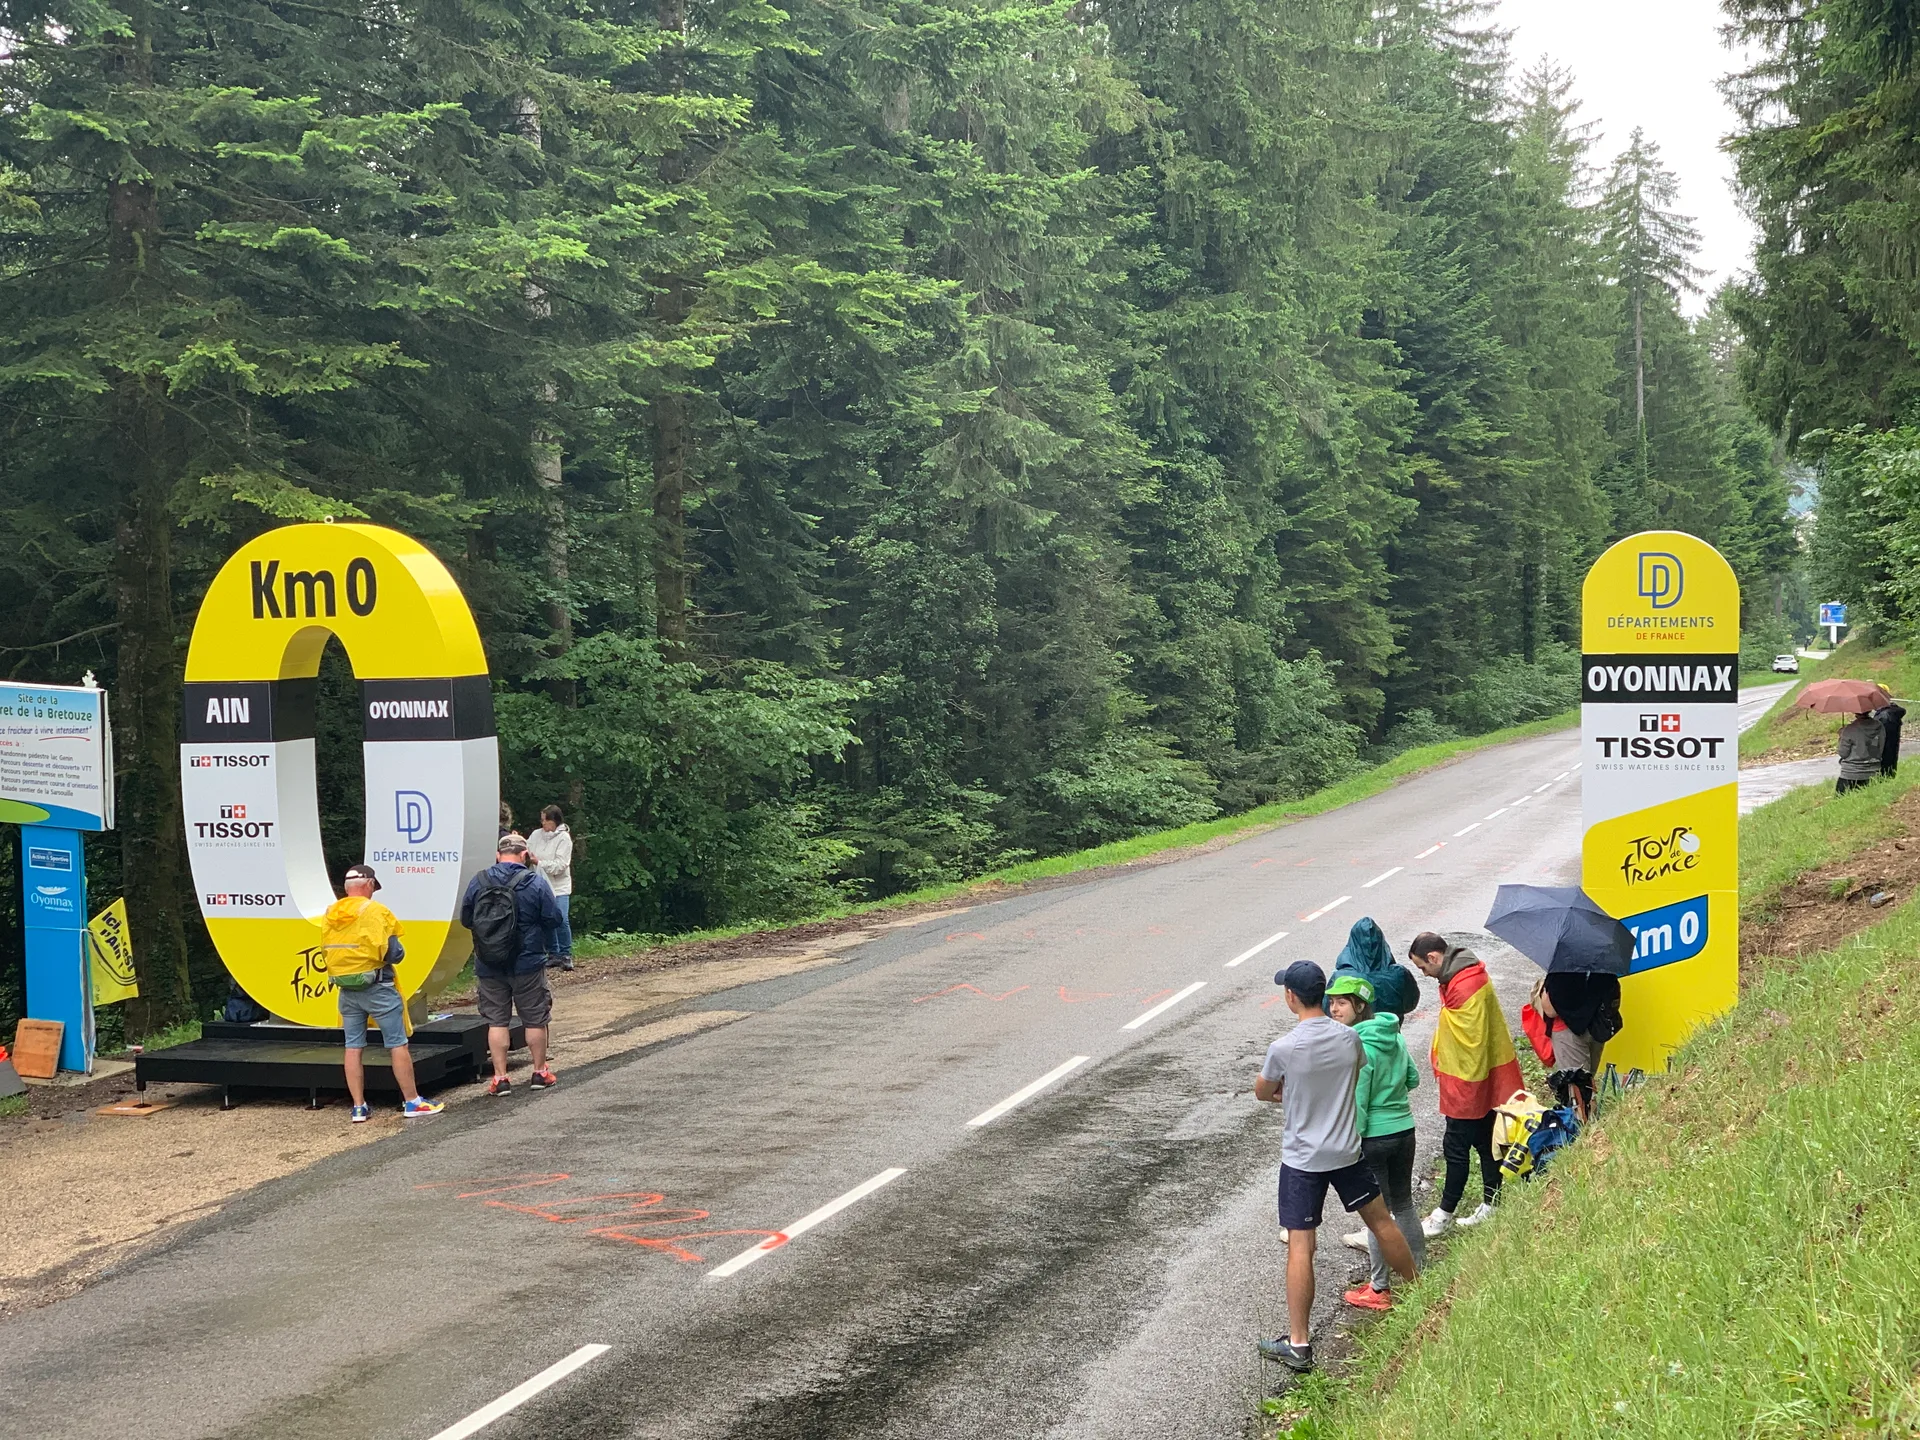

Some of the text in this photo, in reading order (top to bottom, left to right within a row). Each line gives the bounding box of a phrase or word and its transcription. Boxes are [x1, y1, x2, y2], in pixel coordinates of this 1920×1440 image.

[250, 557, 377, 619] Km 0
[1607, 614, 1715, 628] DÉPARTEMENTS
[1636, 632, 1685, 640] DE FRANCE
[1587, 665, 1732, 692] OYONNAX
[18, 693, 58, 705] Site de la
[0, 706, 92, 722] ret de la Bretouze
[206, 697, 250, 724] AIN
[369, 700, 449, 720] OYONNAX
[35, 725, 38, 734] à
[40, 726, 54, 734] vivre
[1596, 737, 1724, 759] TISSOT
[213, 755, 270, 768] TISSOT
[67, 781, 98, 790] d'orientation
[194, 822, 274, 838] TISSOT
[373, 848, 459, 863] DÉPARTEMENTS
[1670, 848, 1681, 858] de
[395, 866, 435, 874] DE FRANCE
[31, 892, 74, 908] Oyonnax
[228, 894, 286, 906] TISSOT
[1680, 910, 1699, 944] 0
